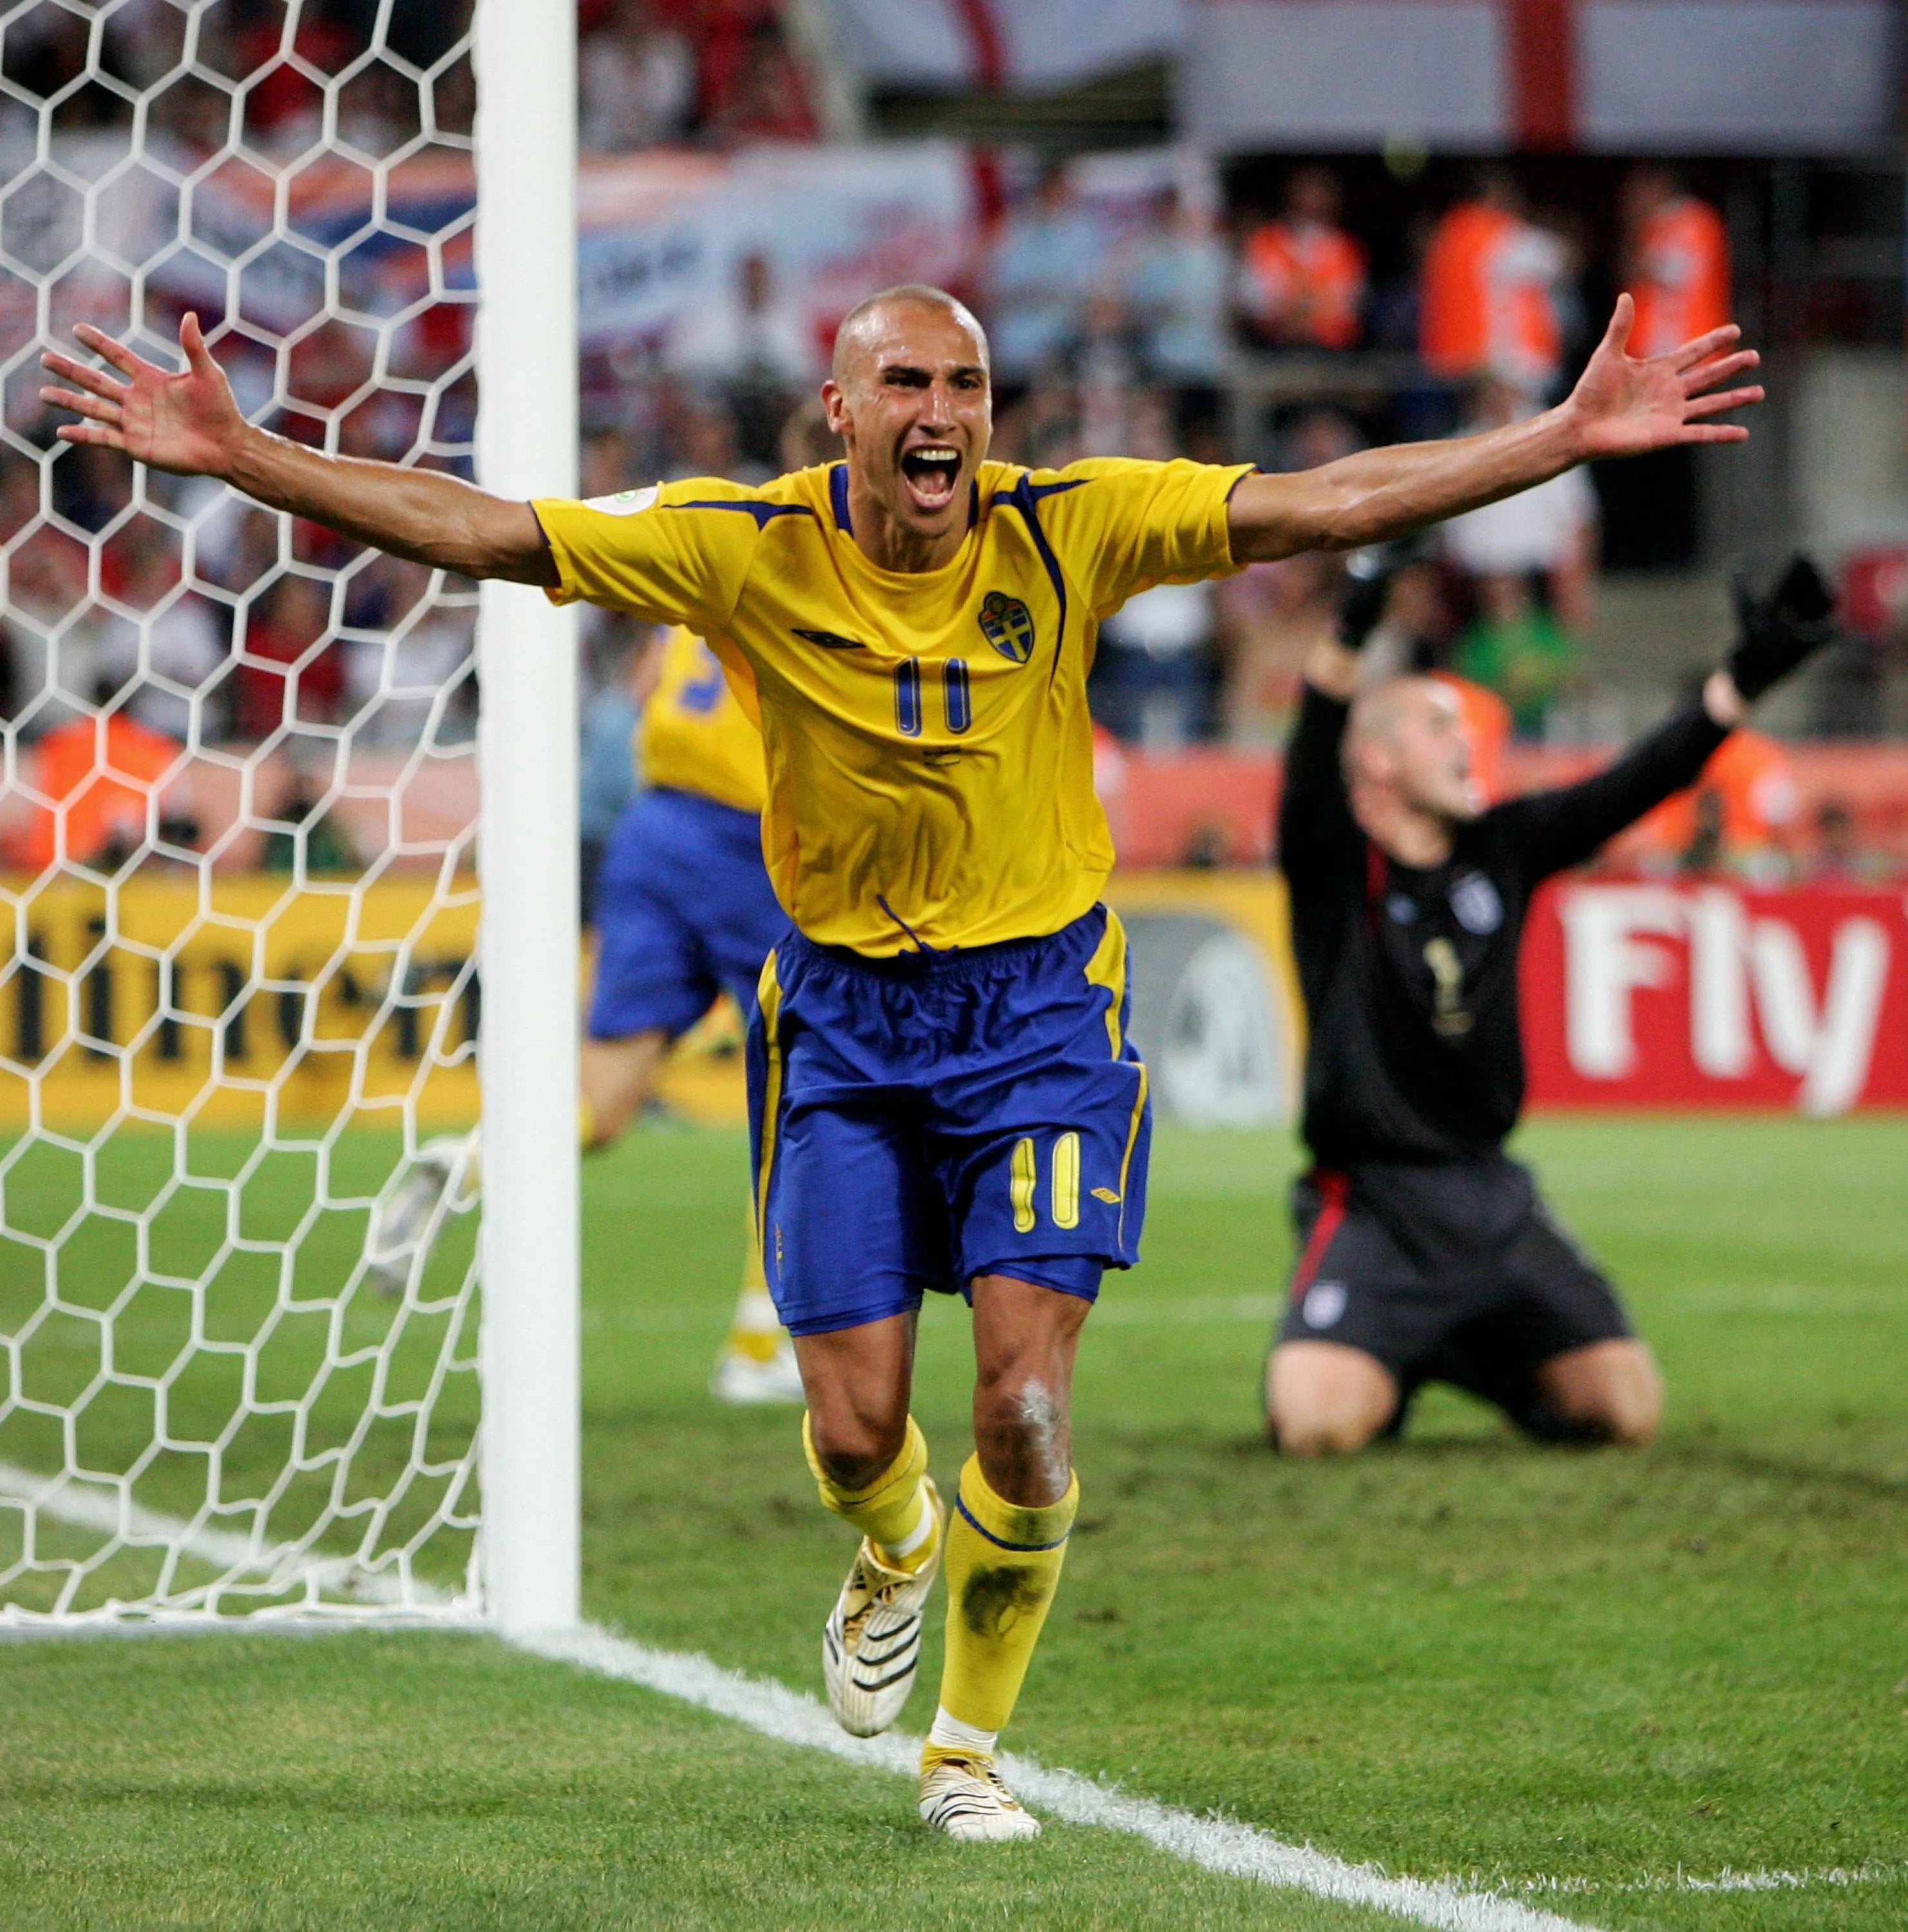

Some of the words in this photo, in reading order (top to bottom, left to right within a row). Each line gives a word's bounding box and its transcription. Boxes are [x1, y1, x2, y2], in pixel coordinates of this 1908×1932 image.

[893, 656, 972, 737] 11
[1559, 884, 1891, 1119] Fly
[1009, 1131, 1080, 1233] 11
